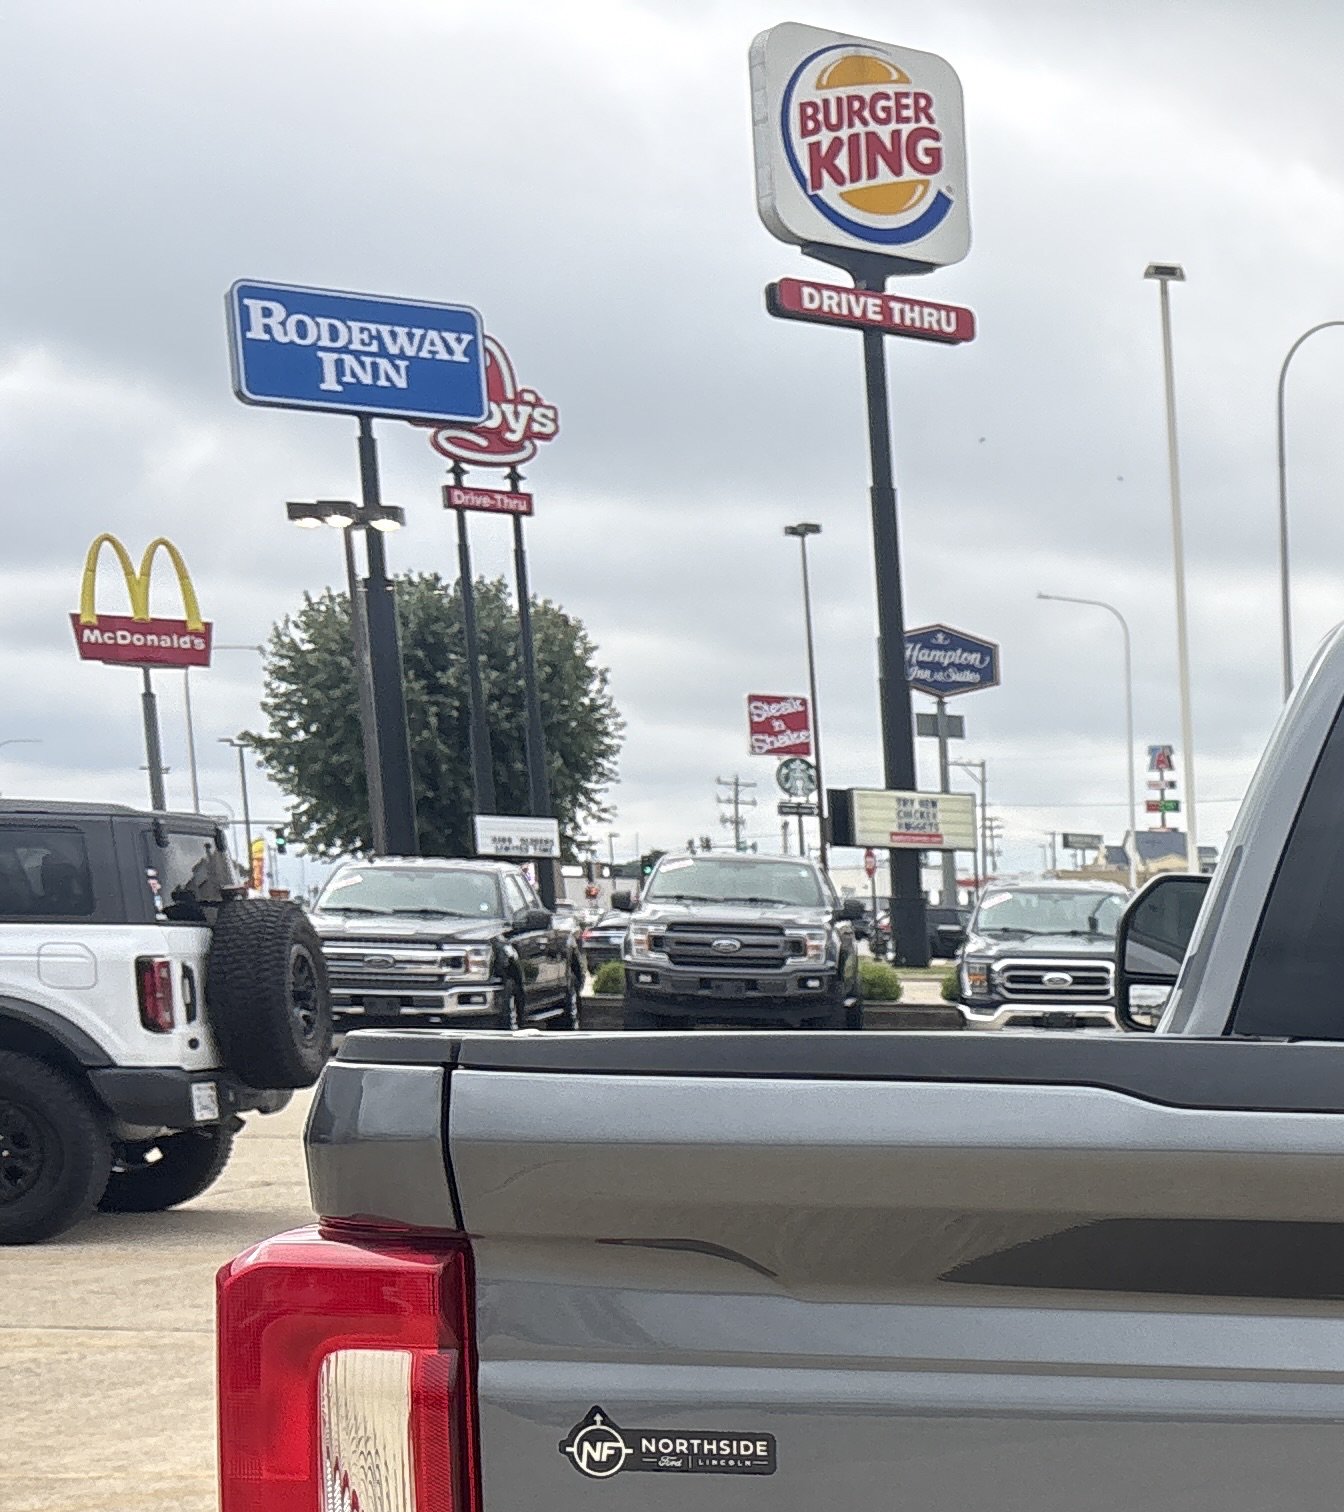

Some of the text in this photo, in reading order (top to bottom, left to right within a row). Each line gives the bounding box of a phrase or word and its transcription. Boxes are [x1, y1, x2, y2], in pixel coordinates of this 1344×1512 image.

[799, 91, 937, 139] BURGER
[808, 127, 943, 193] KING
[801, 286, 958, 333] DRIVE THRU
[243, 297, 474, 364] RODEWAY
[317, 350, 410, 393] INN
[452, 488, 528, 511] Drive-Thru
[82, 628, 207, 651] McDonald's
[904, 642, 991, 669] Hampton
[582, 1437, 769, 1467] NF NORTHSIDE
[698, 1459, 752, 1467] LINCOLN
